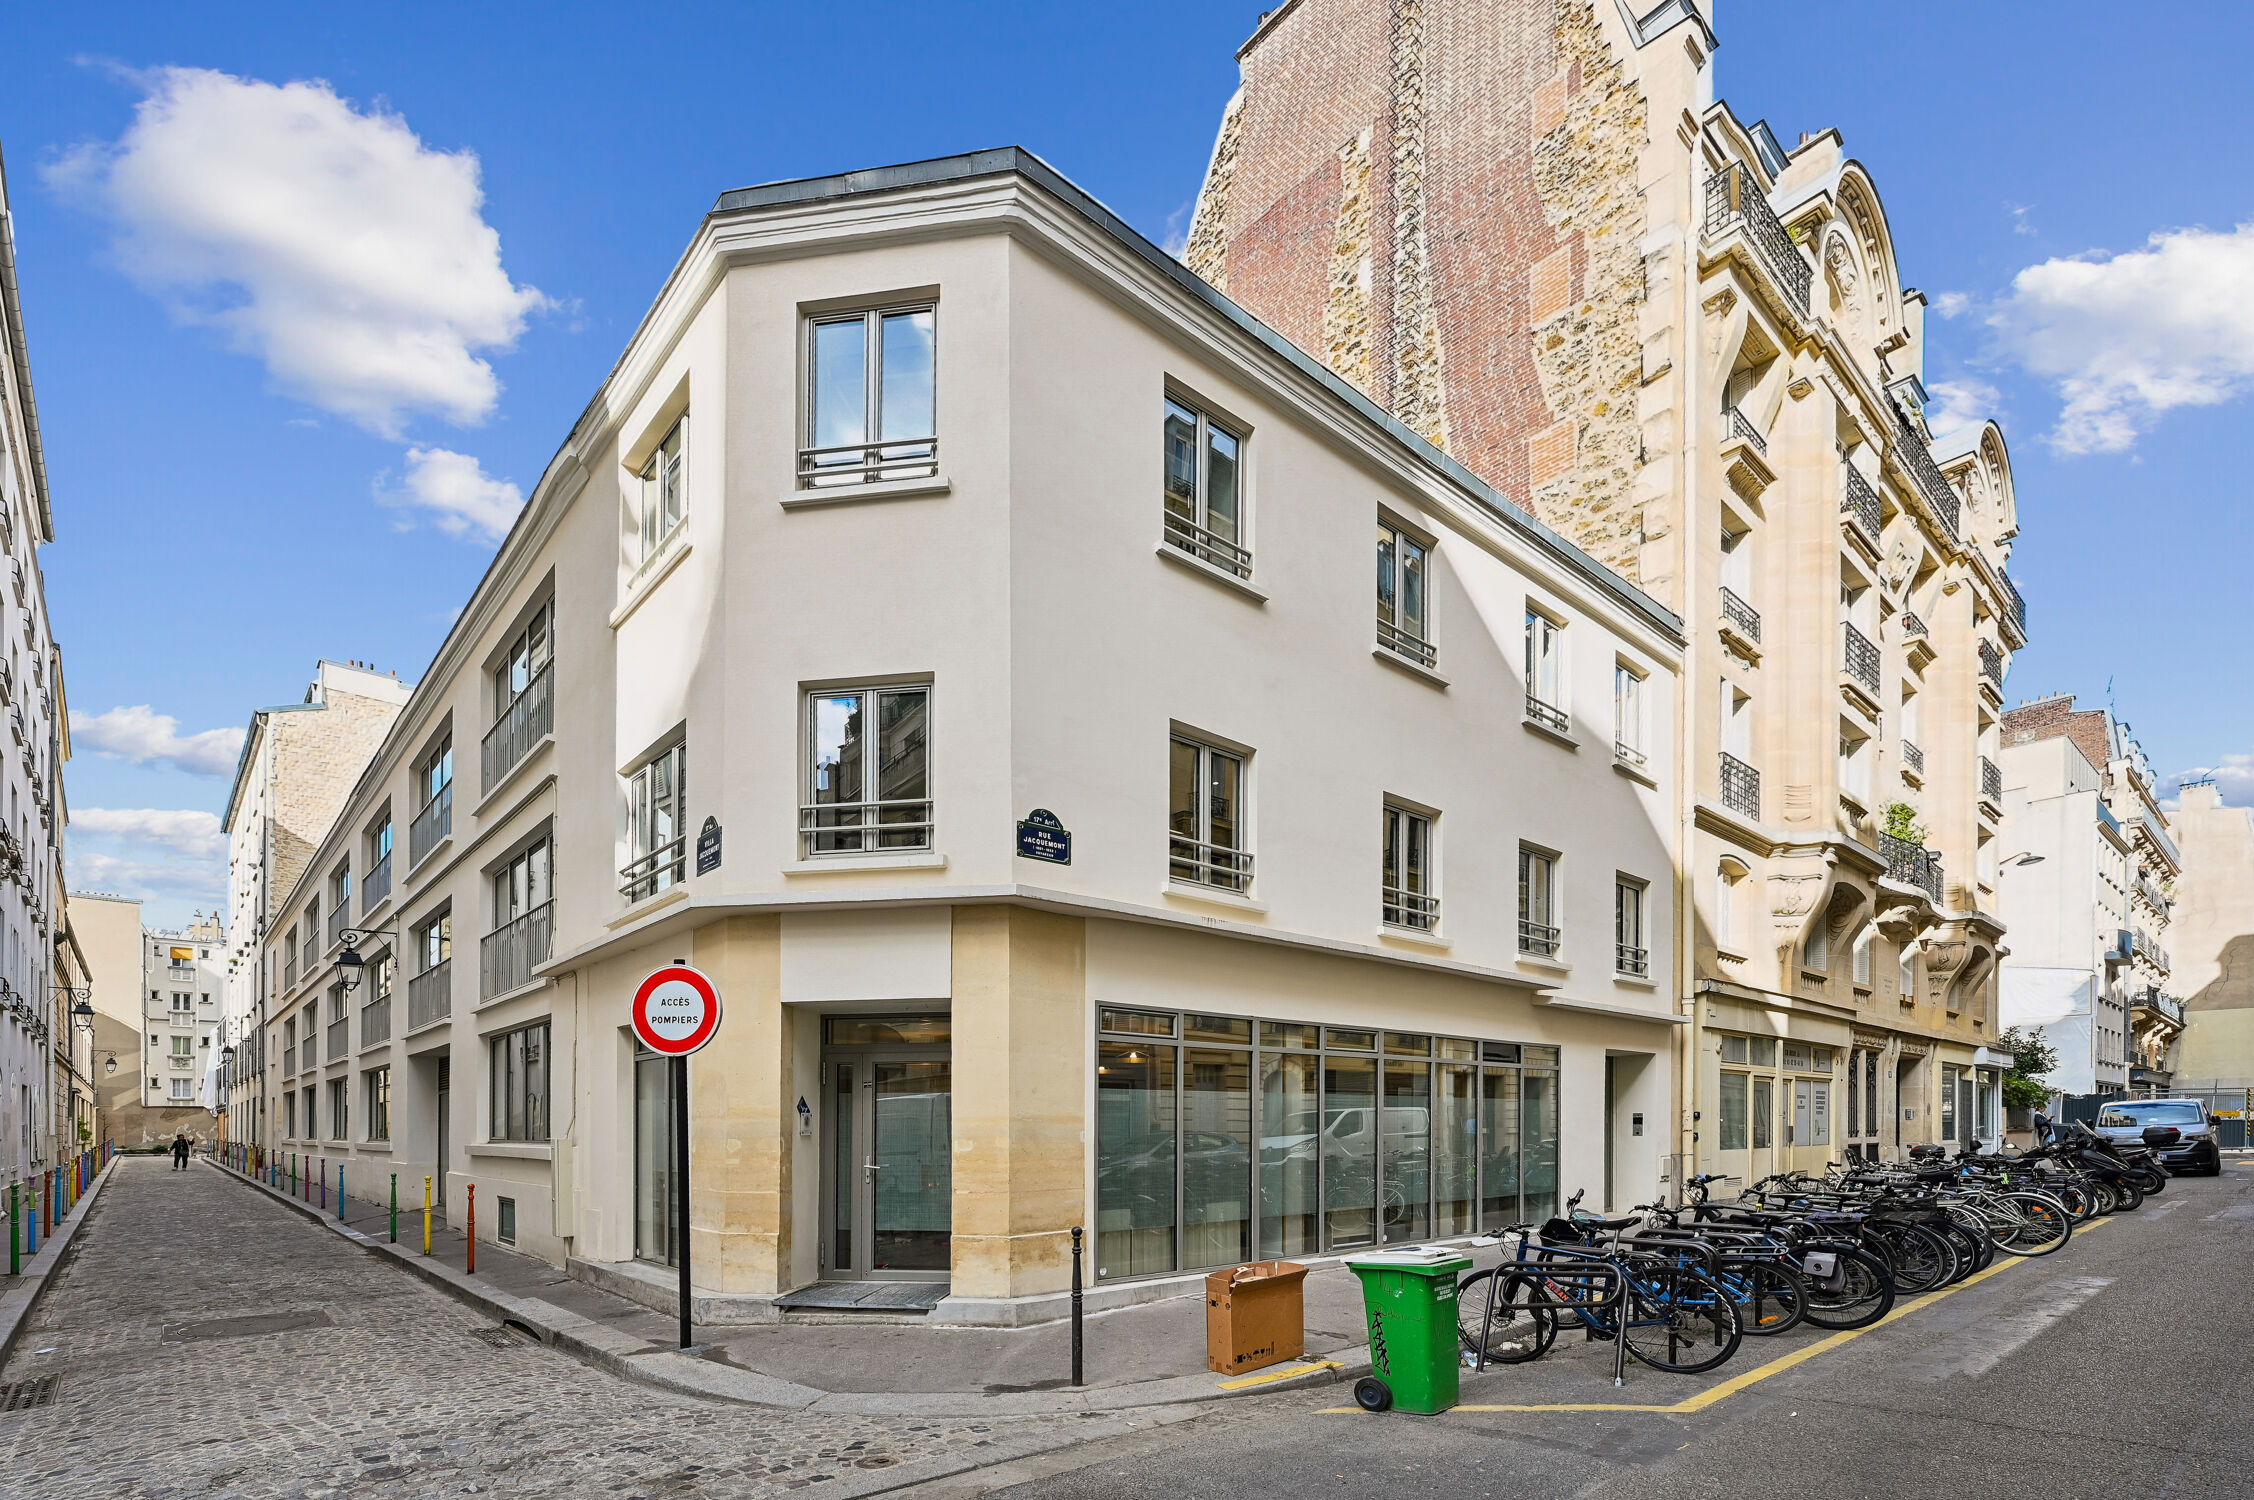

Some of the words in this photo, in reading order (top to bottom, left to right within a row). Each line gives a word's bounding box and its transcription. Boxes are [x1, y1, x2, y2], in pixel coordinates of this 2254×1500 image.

[1038, 831, 1051, 840] RUE
[1023, 836, 1066, 850] JACQUEMONT
[660, 997, 690, 1007] ACCÈS
[651, 1016, 699, 1024] POMPIERS
